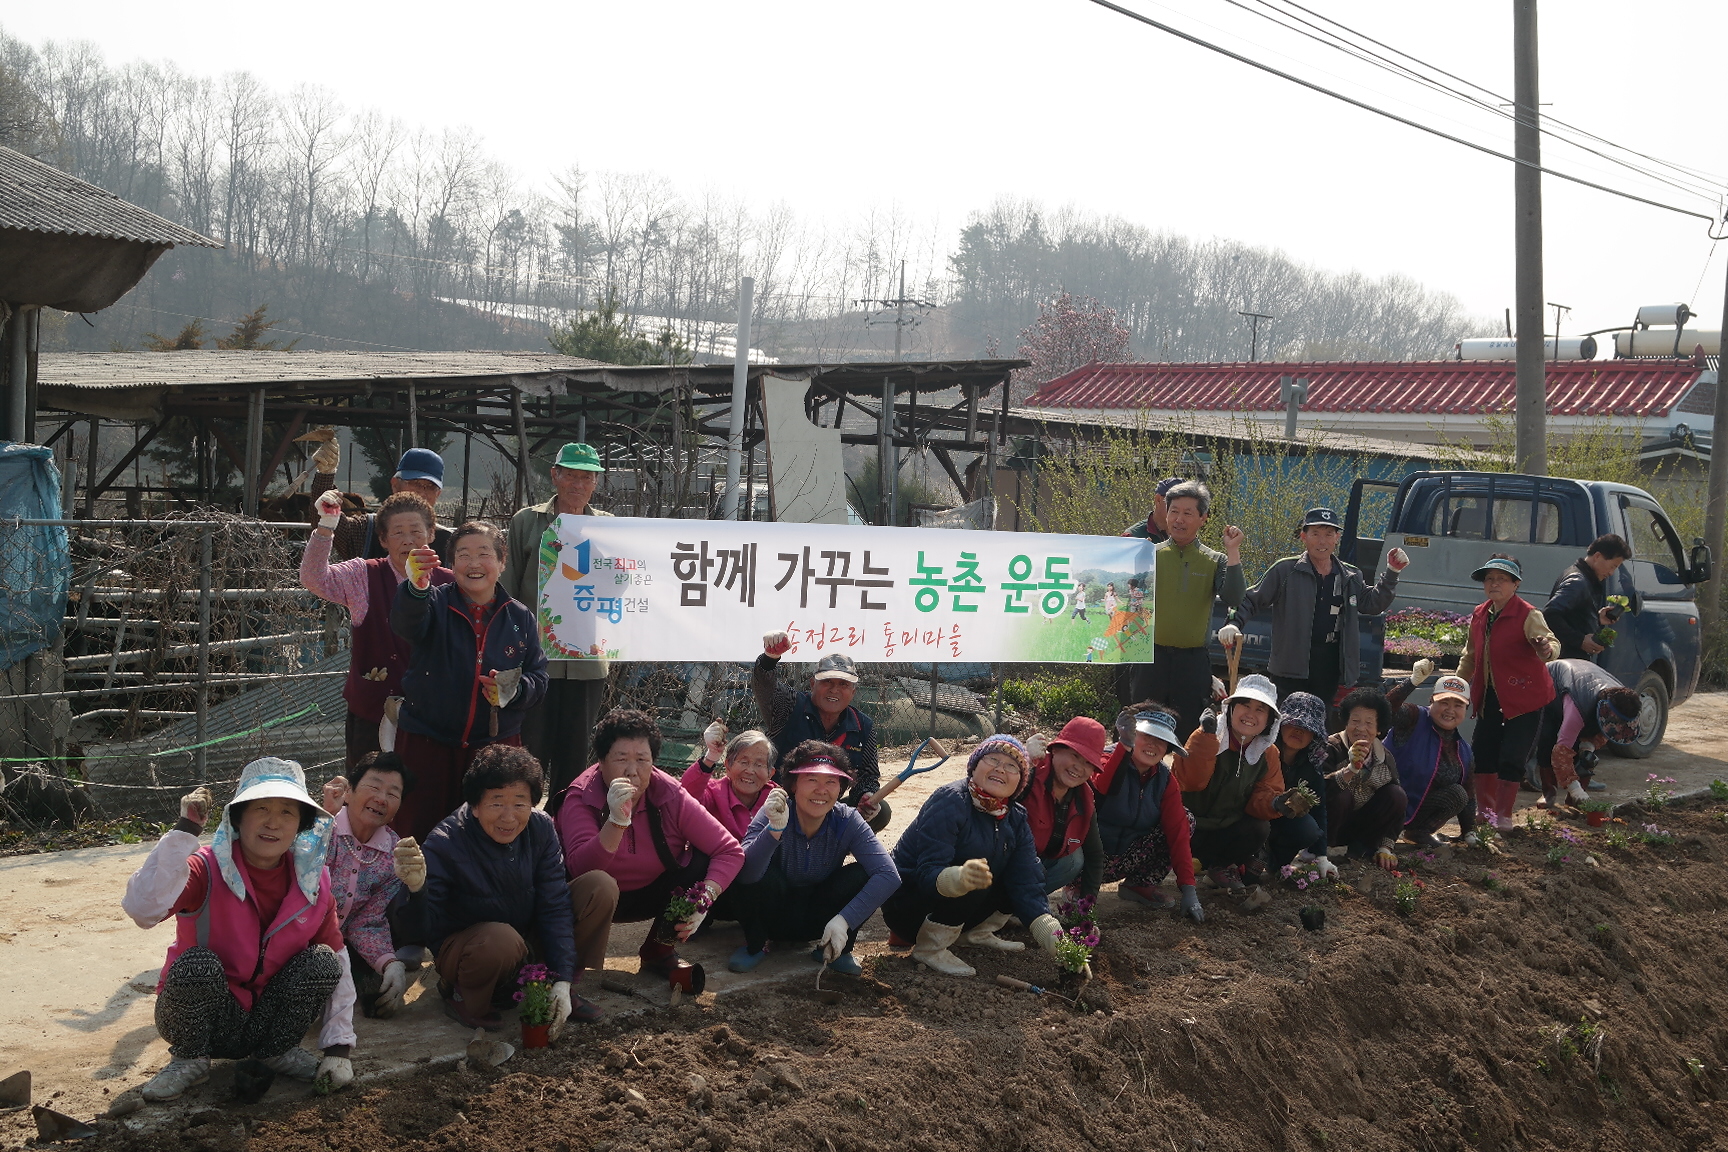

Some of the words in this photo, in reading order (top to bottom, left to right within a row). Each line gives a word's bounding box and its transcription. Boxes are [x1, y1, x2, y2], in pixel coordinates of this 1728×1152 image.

[593, 558, 612, 570] 전국
[614, 557, 647, 572] 최고의
[670, 540, 758, 608] 함께
[774, 545, 895, 610] 가꾸는
[908, 550, 987, 613] 농촌
[1000, 554, 1075, 615] 운동
[883, 622, 962, 658] 통미마을
